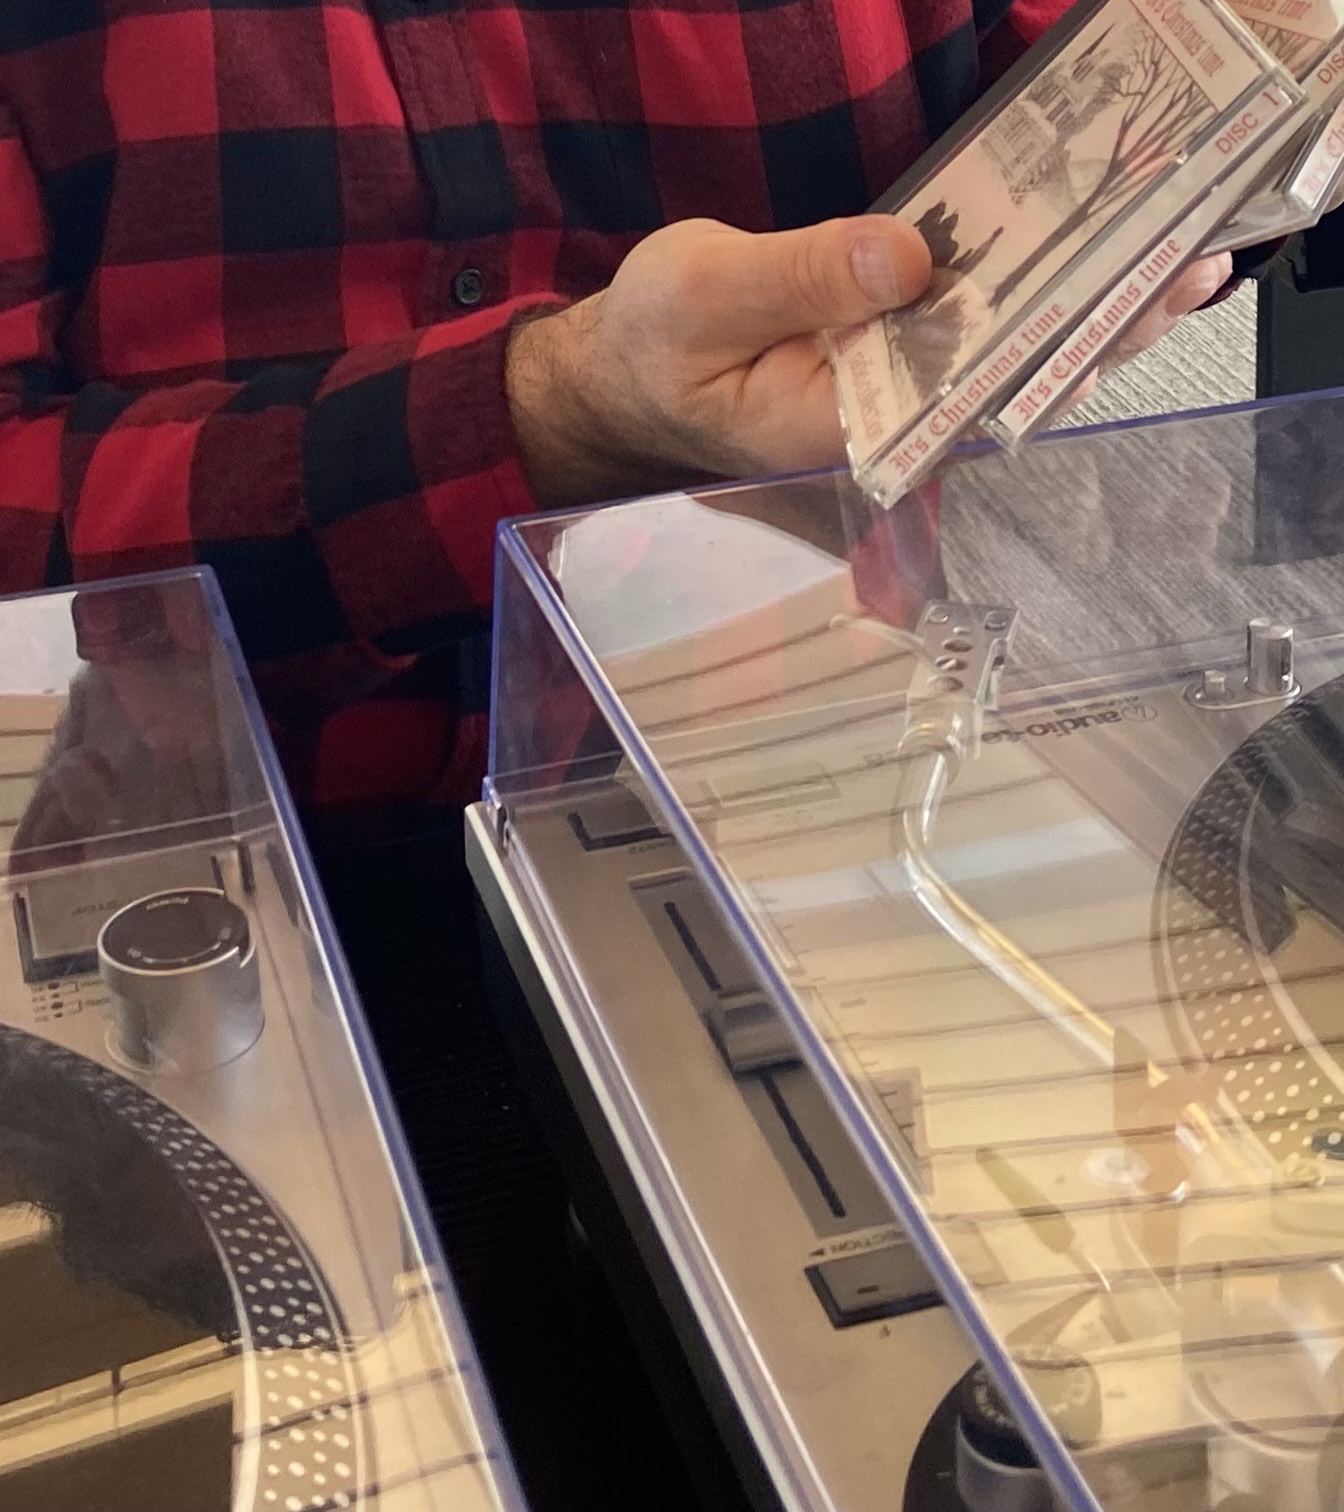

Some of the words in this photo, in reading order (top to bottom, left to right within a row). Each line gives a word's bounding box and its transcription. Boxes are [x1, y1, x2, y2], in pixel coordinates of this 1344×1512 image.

[1216, 111, 1260, 156] DISC
[1261, 90, 1280, 107] 1
[888, 437, 930, 477] It's
[927, 345, 1024, 439] Christmas
[1020, 301, 1067, 348] time
[1012, 380, 1052, 424] It's
[1050, 284, 1142, 381] Christmas
[1138, 238, 1183, 284] time
